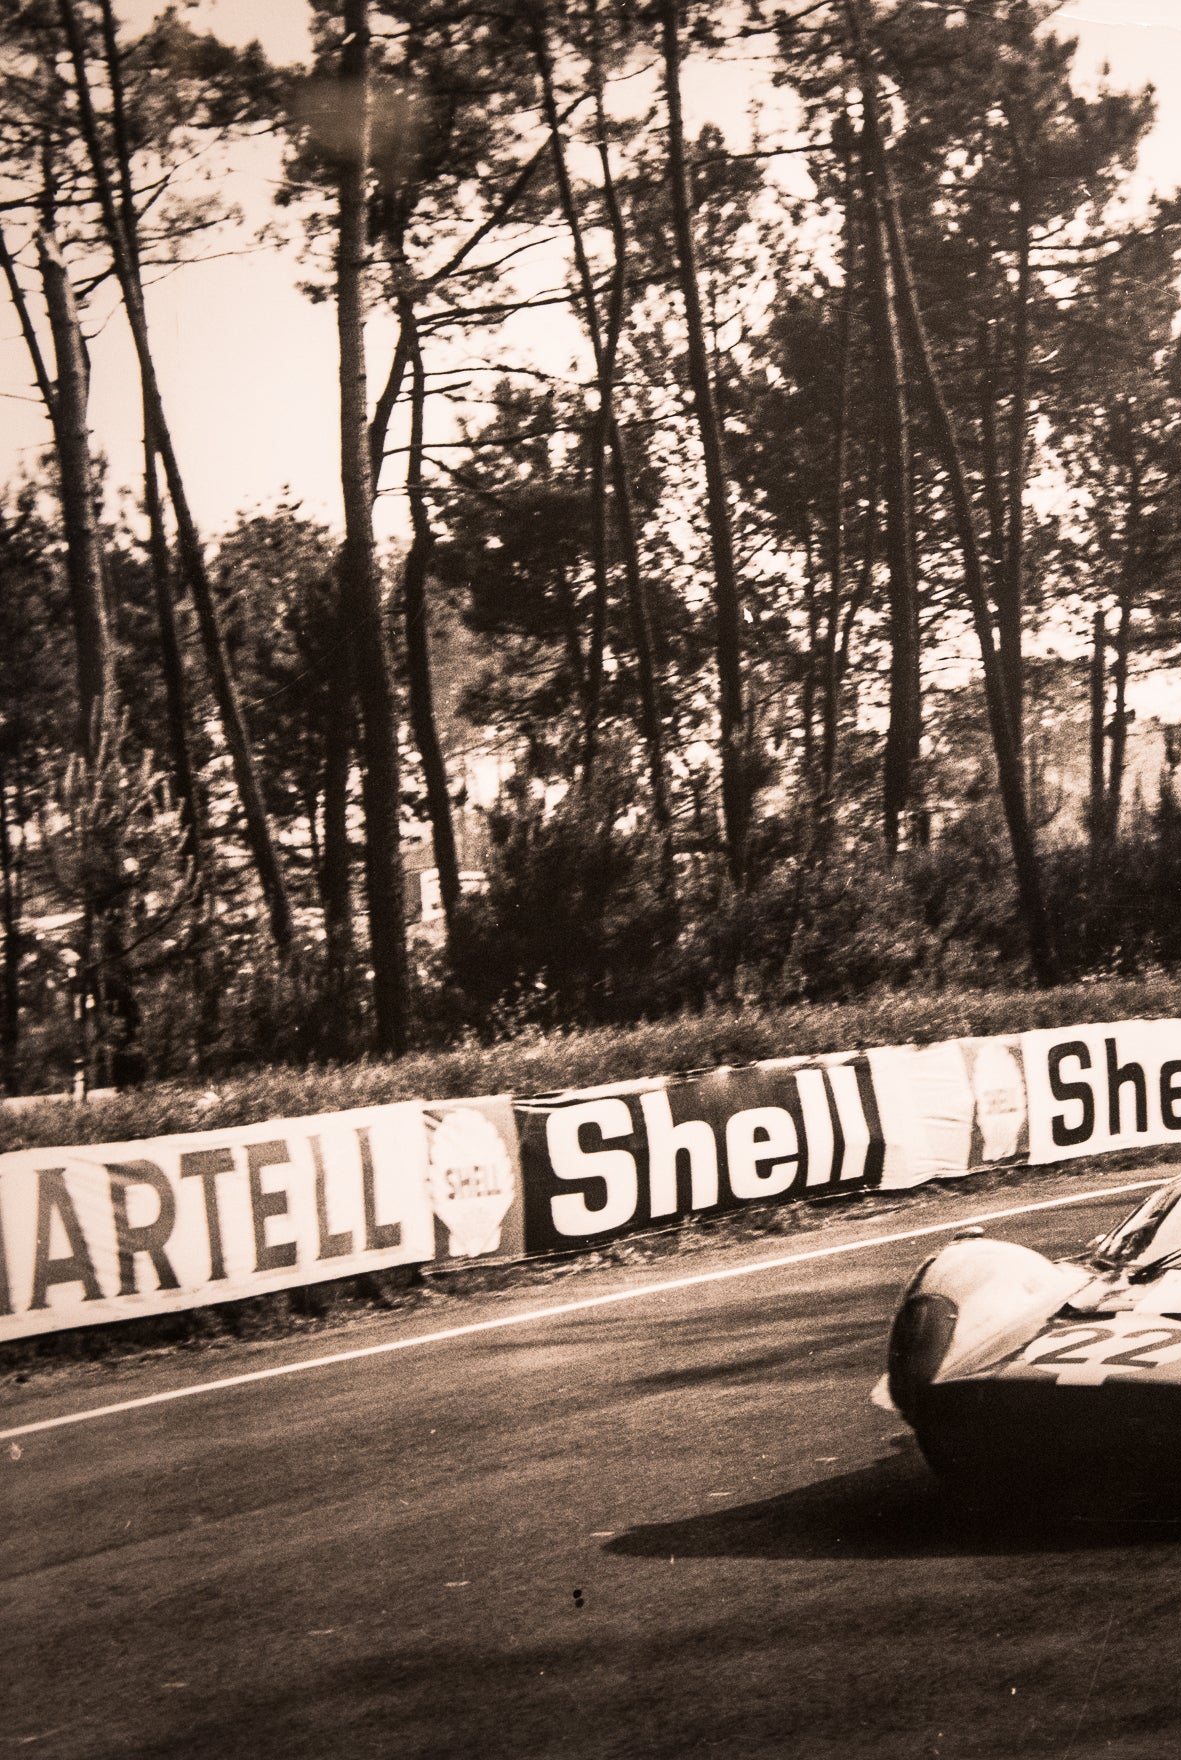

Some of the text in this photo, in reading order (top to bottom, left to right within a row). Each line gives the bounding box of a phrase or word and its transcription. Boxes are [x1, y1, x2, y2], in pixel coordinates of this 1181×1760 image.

[0, 1126, 402, 1316] ARTELL
[446, 1165, 501, 1200] SHELL
[546, 1065, 869, 1237] Shell
